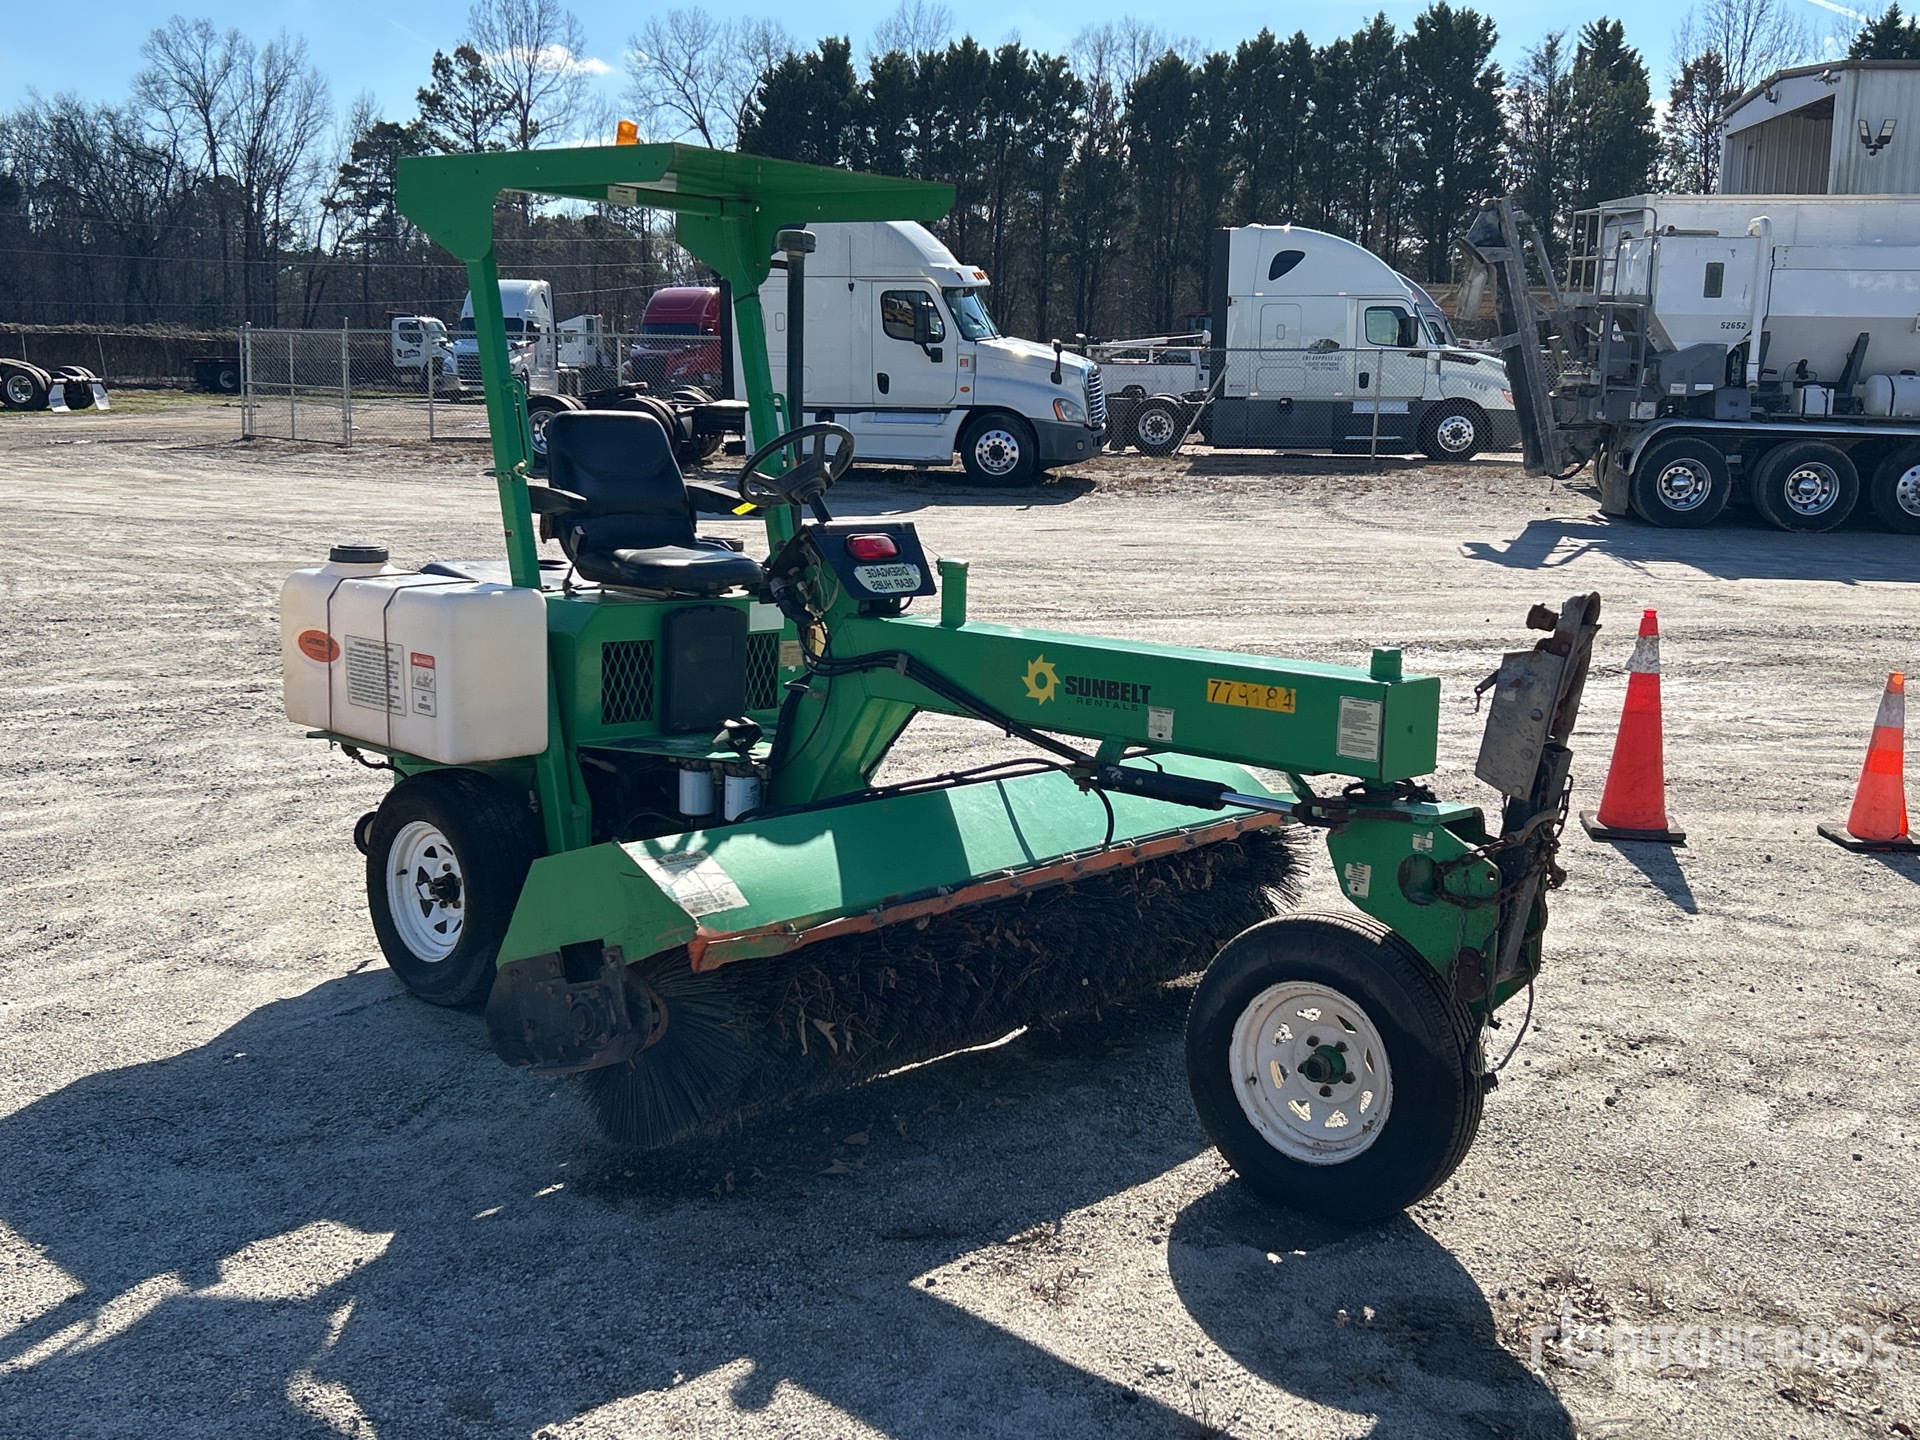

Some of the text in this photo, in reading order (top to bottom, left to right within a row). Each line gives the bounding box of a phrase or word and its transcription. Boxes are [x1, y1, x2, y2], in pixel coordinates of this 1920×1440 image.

[1720, 321, 1747, 330] 52652
[1064, 675, 1152, 705] SUNBELT
[1209, 680, 1295, 711] 779184
[1076, 697, 1139, 712] RENTALS
